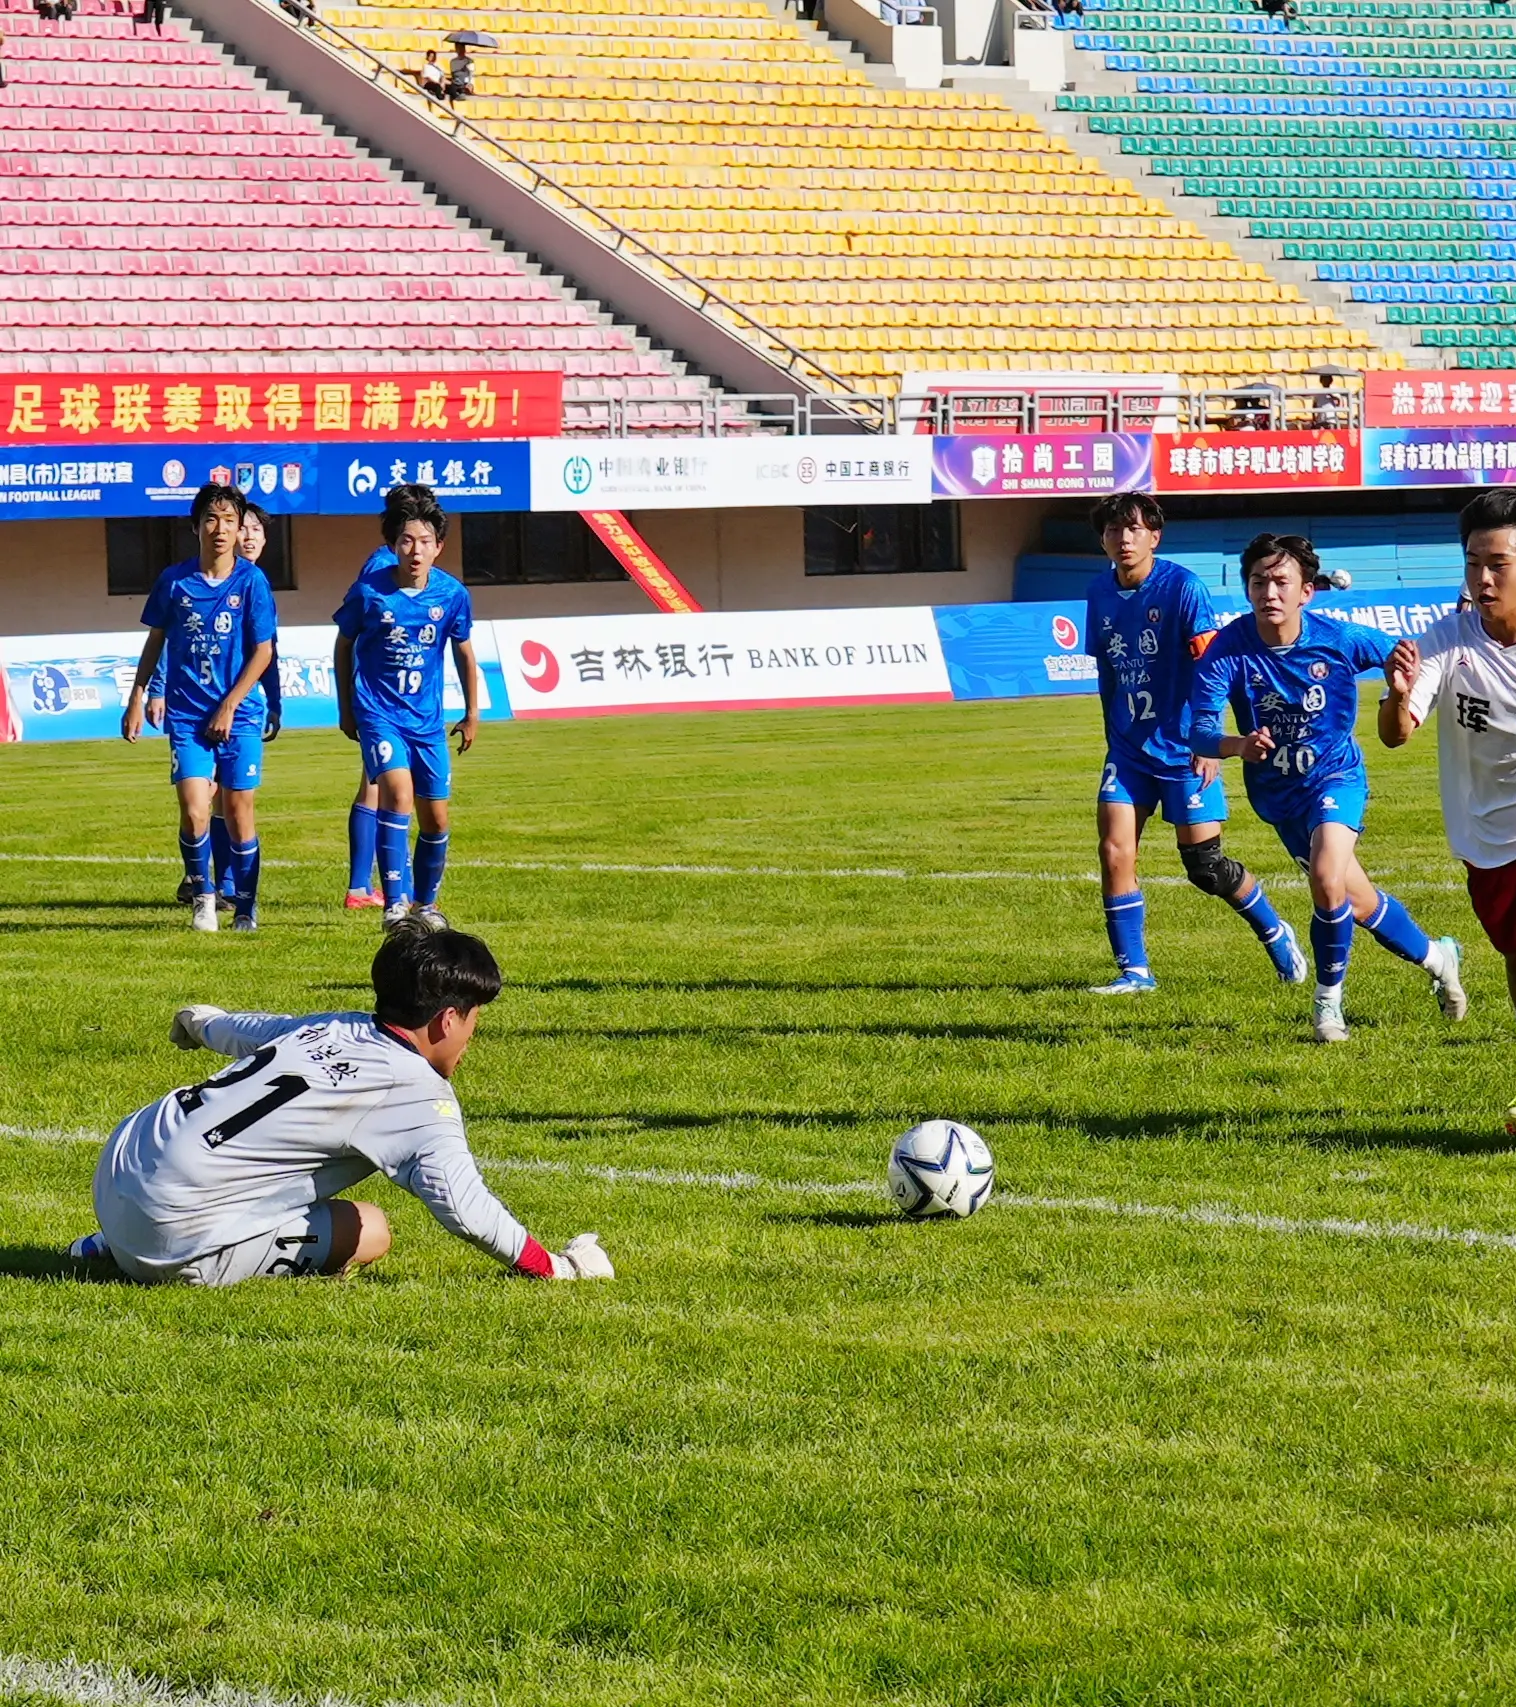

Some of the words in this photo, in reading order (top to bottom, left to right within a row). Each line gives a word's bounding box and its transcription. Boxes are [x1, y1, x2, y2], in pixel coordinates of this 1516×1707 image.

[756, 461, 790, 480] ICBC
[825, 459, 910, 478] 中国工商银行
[1002, 443, 1114, 474] 拾尚工园
[1169, 443, 1345, 476] 珲春市博宇职业培训学校
[8, 490, 60, 503] FOOTBALL
[61, 488, 101, 501] LEAGUE
[1002, 478, 1018, 490] SHI
[1020, 477, 1053, 490] SHANG
[1056, 477, 1085, 489] GONG
[1088, 476, 1115, 488] YUAN
[747, 647, 819, 669] BANK
[825, 645, 856, 667] OF
[865, 643, 929, 665] JILIN
[1106, 628, 1159, 659] 安图
[200, 660, 212, 685] 5
[571, 642, 734, 682] 吉林银行
[1120, 658, 1145, 670] ANTU
[397, 669, 423, 695] 19
[1127, 690, 1157, 723] 12
[1254, 684, 1327, 713] 安图
[1271, 713, 1310, 723] ANTU
[370, 740, 394, 768] 19
[1272, 745, 1315, 776] 40
[174, 1045, 311, 1150] 21
